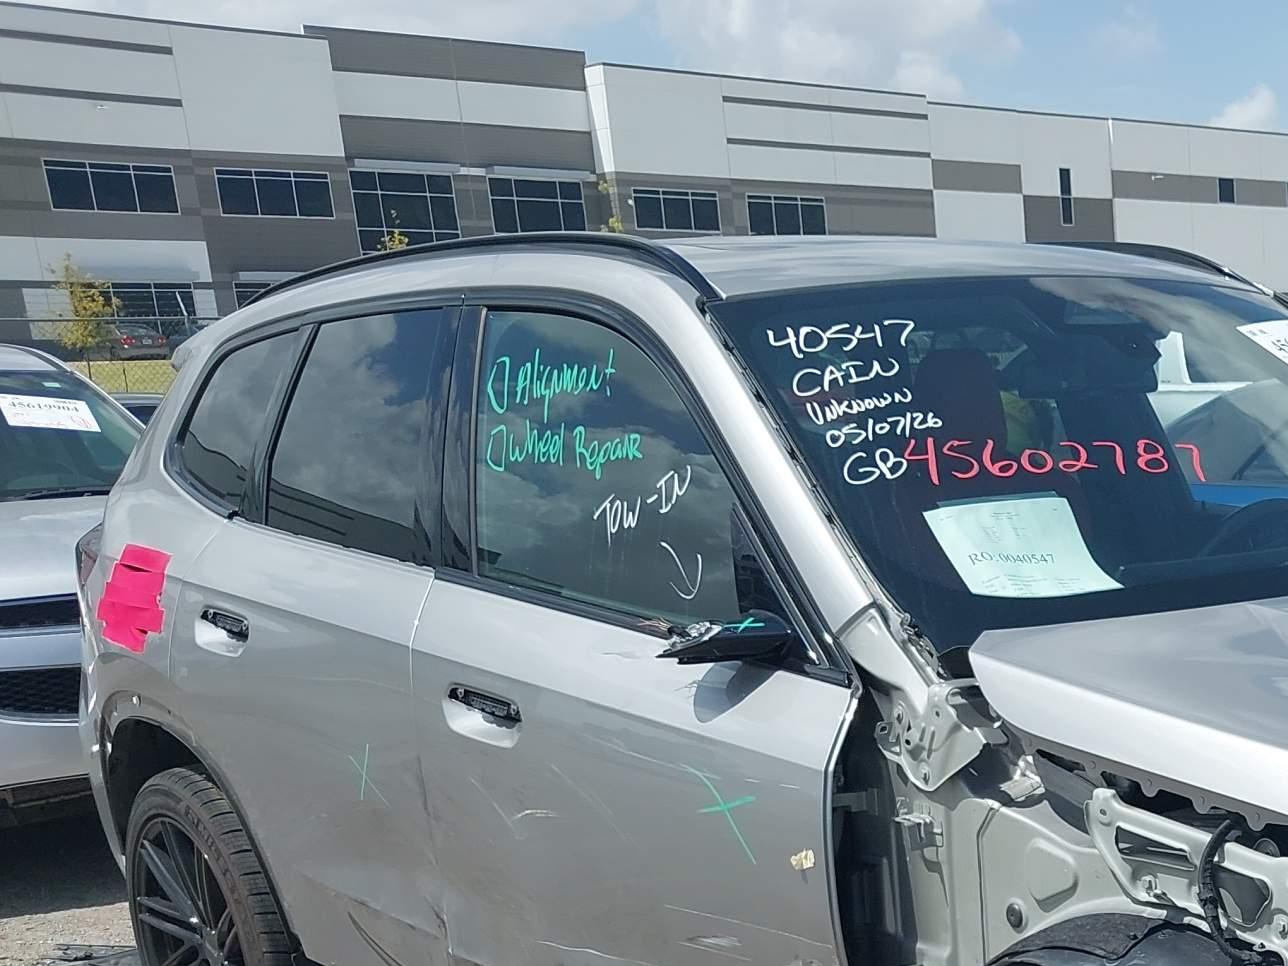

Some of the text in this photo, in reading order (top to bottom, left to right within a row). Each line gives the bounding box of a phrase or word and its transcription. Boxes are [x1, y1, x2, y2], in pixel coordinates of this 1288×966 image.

[766, 319, 916, 359] 40547
[792, 357, 900, 397] CAIN
[825, 411, 943, 448] 05/07/26
[842, 447, 908, 485] GB
[903, 436, 1207, 486] 45602787
